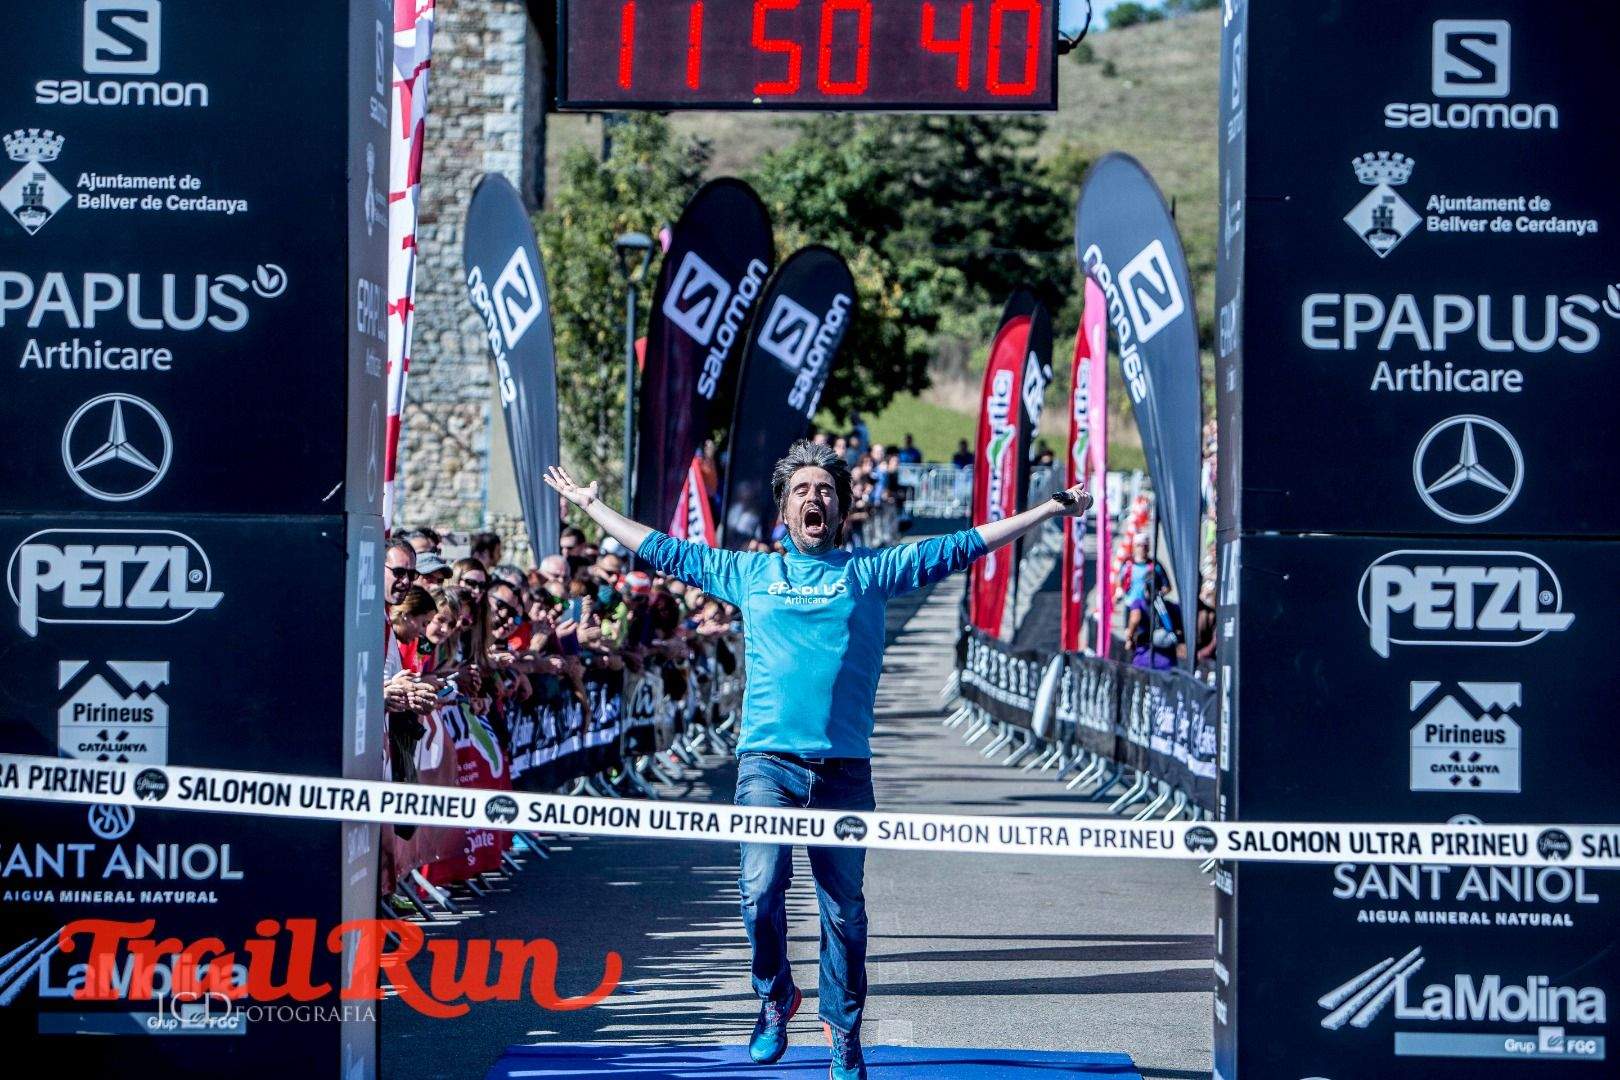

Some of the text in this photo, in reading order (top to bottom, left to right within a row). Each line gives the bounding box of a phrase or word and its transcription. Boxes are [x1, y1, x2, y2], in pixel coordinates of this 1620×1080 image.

[752, 0, 872, 95] 50
[919, 0, 1042, 95] 40
[77, 172, 201, 191] Ajuntament de
[77, 193, 248, 215] Bellver de Cerdanya
[1426, 194, 1551, 214] Ajuntament de
[1426, 215, 1599, 236] Bellver de Cerdanya
[0, 270, 250, 333] PAPLUS
[1301, 292, 1601, 354] EPAPLUS
[19, 338, 174, 372] Arthicare
[1370, 360, 1524, 393] Arthicare
[784, 596, 828, 605] Arthicare
[73, 702, 154, 723] Pirineus
[1425, 723, 1506, 744] Pirineus
[78, 743, 148, 752] CATALUNYA
[1430, 764, 1500, 774] CATALUNYA
[28, 764, 126, 796] PIRINEU
[177, 775, 292, 807] SALOMON
[300, 785, 371, 812] ULTRA
[380, 791, 476, 819] PIRINEU
[528, 802, 641, 829] SALOMON
[650, 809, 720, 833] ULTRA
[729, 814, 825, 838] PIRINEU
[877, 820, 990, 845] SALOMON
[998, 825, 1070, 847] ULTRA
[1079, 828, 1175, 850] PIRINEU
[1227, 830, 1341, 854] SALOMON
[1350, 831, 1420, 855] ULTRA
[1431, 832, 1528, 858] PIRINEU
[0, 842, 244, 880] ANT ANIOL
[1332, 862, 1600, 904] SANT ANIOL
[3, 890, 219, 904] AIGUA MINERAL NATURAL
[1357, 909, 1574, 927] AIGUA MINERAL NATURAL
[1504, 1038, 1537, 1054] Grup
